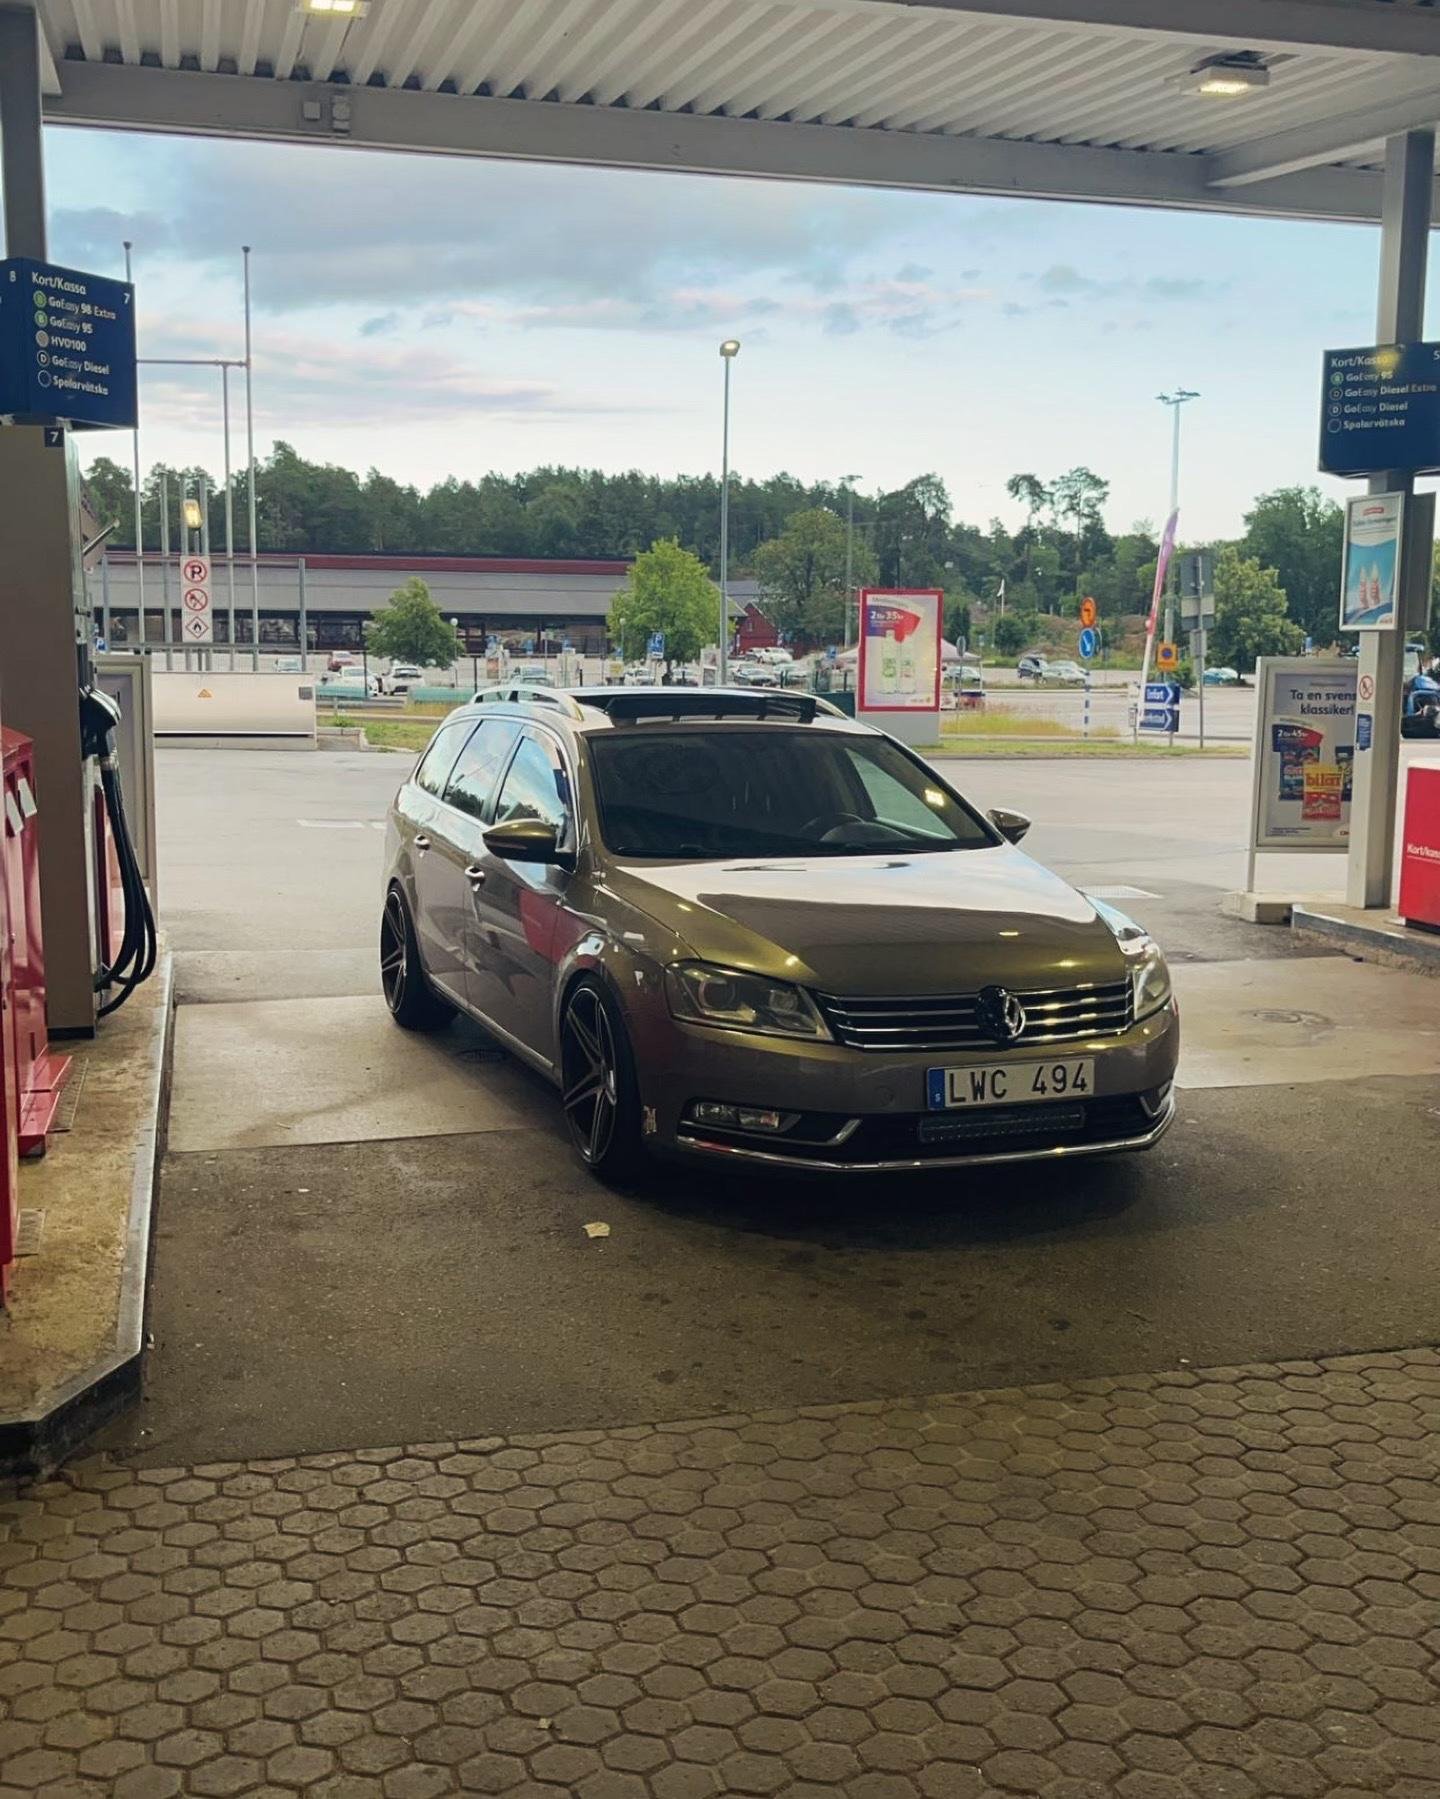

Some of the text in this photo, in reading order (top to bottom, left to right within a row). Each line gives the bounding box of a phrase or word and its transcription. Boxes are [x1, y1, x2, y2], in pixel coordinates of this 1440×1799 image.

[31, 271, 87, 295] Kort/Kassa
[123, 292, 131, 305] 7
[48, 296, 80, 315] GoEasy
[80, 303, 92, 315] 98
[94, 306, 116, 320] Extra
[49, 316, 93, 334] GoEasy 95
[51, 335, 86, 352] HVO100
[52, 355, 110, 375] GoEasy Diesel
[1346, 372, 1378, 383] GoEasy
[1345, 384, 1437, 398] GoEasy Diesel Extra
[1344, 402, 1408, 414] GoEasy Diesel
[50, 431, 58, 443] 7
[1290, 689, 1304, 701] Ta
[1307, 692, 1322, 701] en
[1300, 703, 1355, 715] klassiker!
[1306, 773, 1340, 787] bilar
[949, 1062, 1088, 1104] LWC 494
